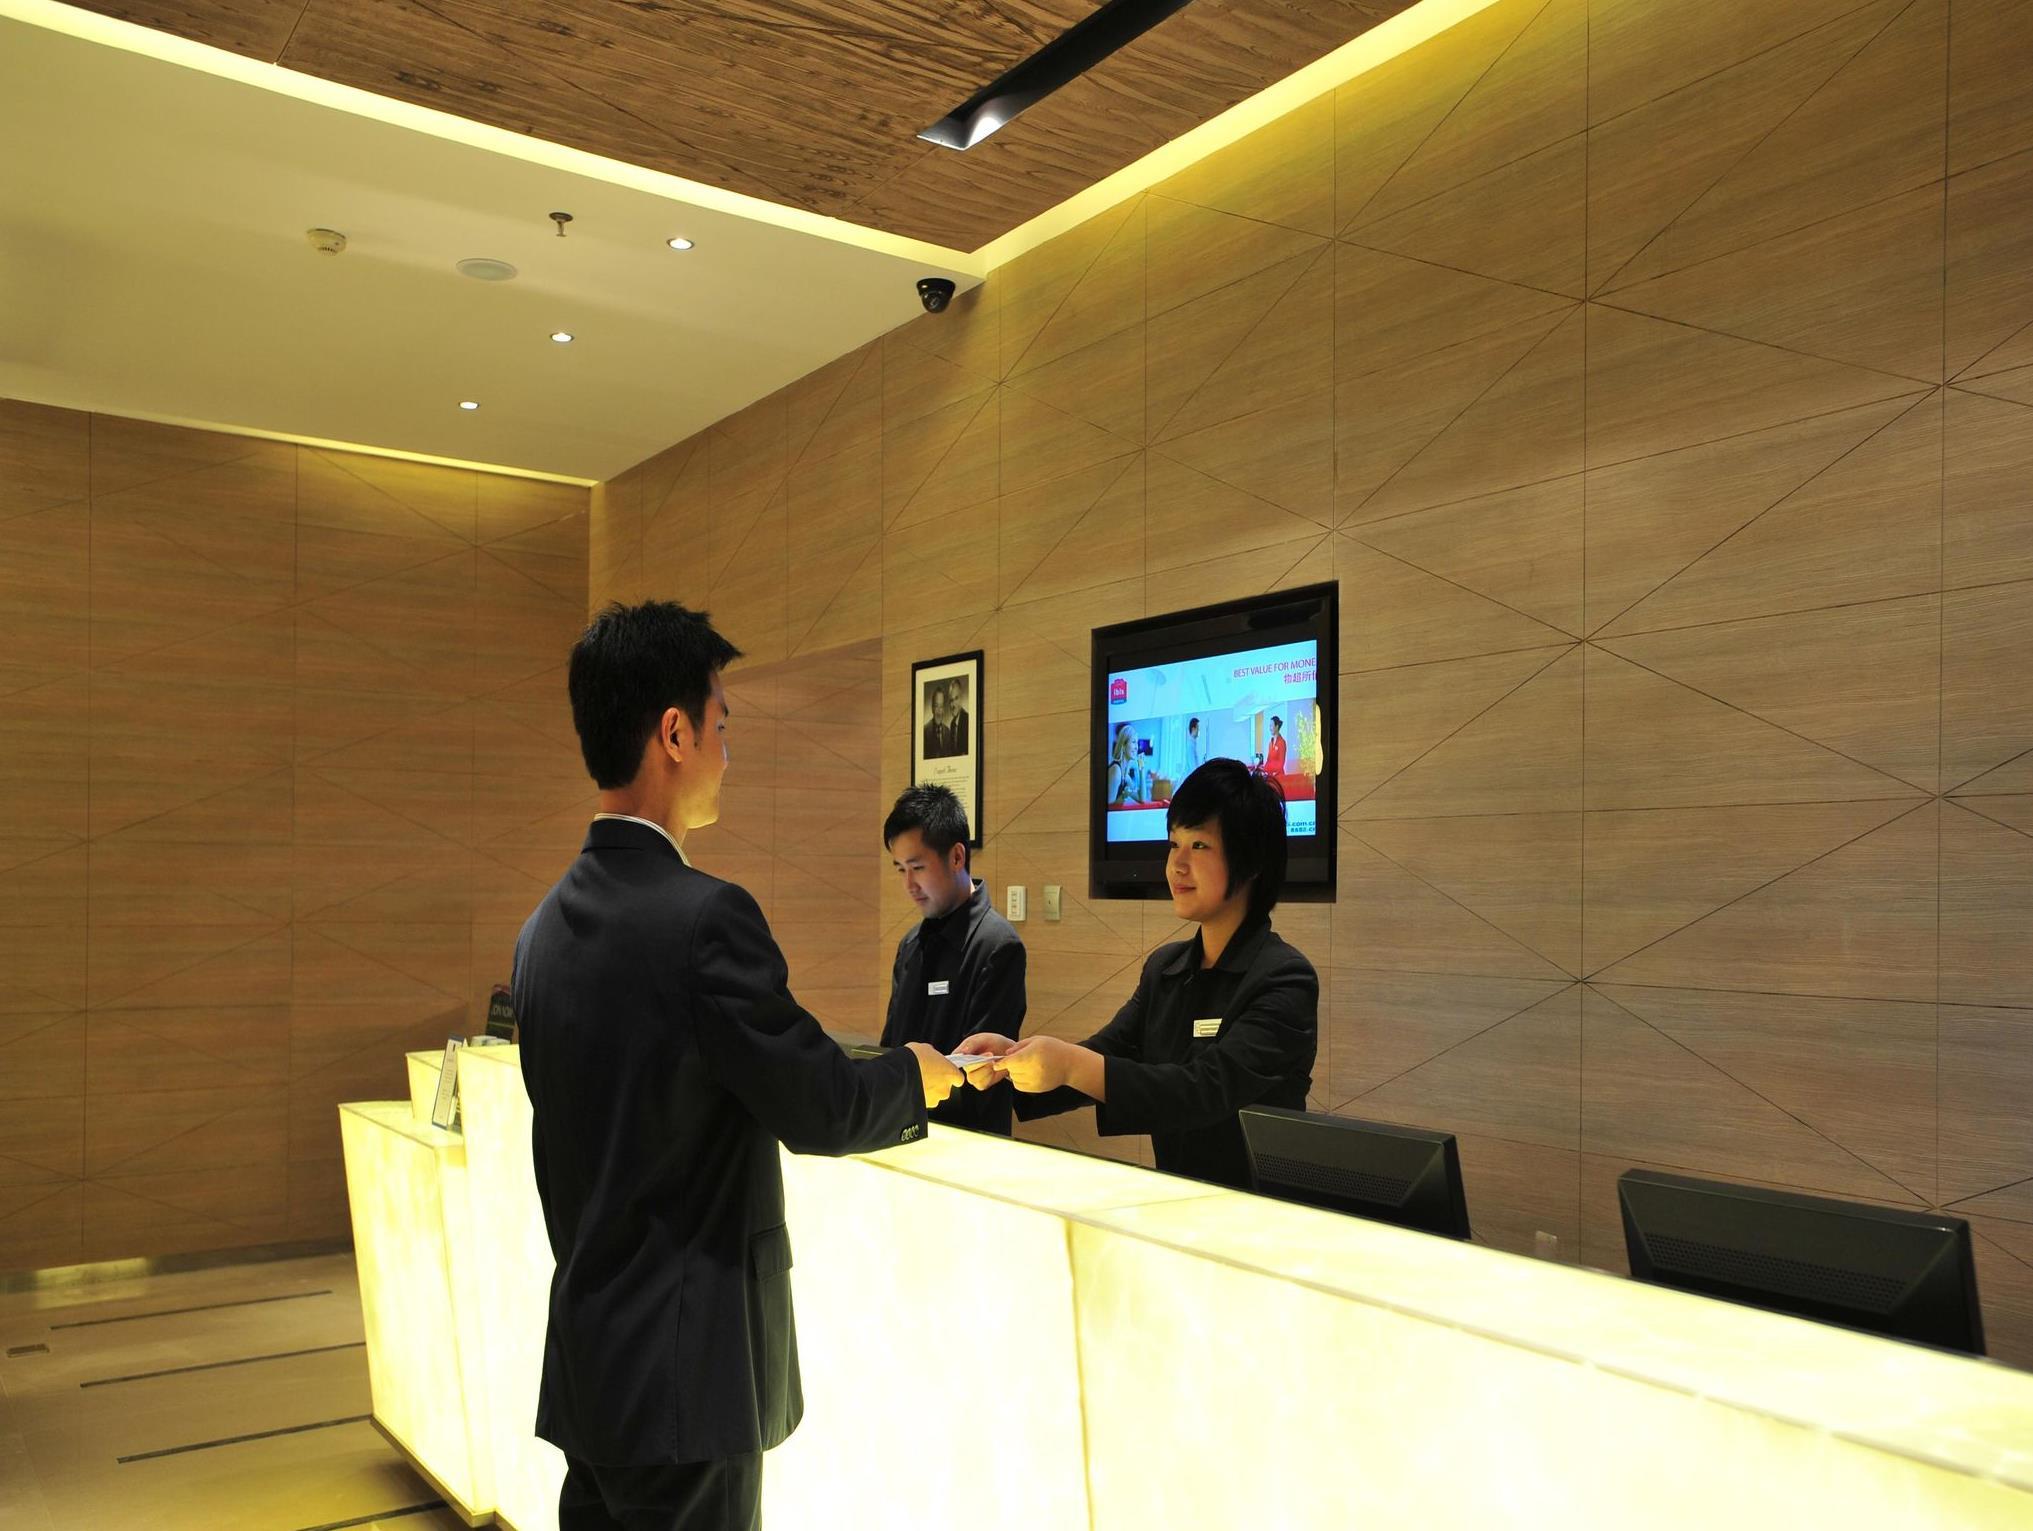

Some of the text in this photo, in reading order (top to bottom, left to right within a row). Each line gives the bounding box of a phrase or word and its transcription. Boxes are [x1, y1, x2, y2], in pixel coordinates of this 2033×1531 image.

[1233, 668, 1249, 678] BEST
[1250, 664, 1272, 675] VALUE
[1273, 662, 1289, 672] FOR
